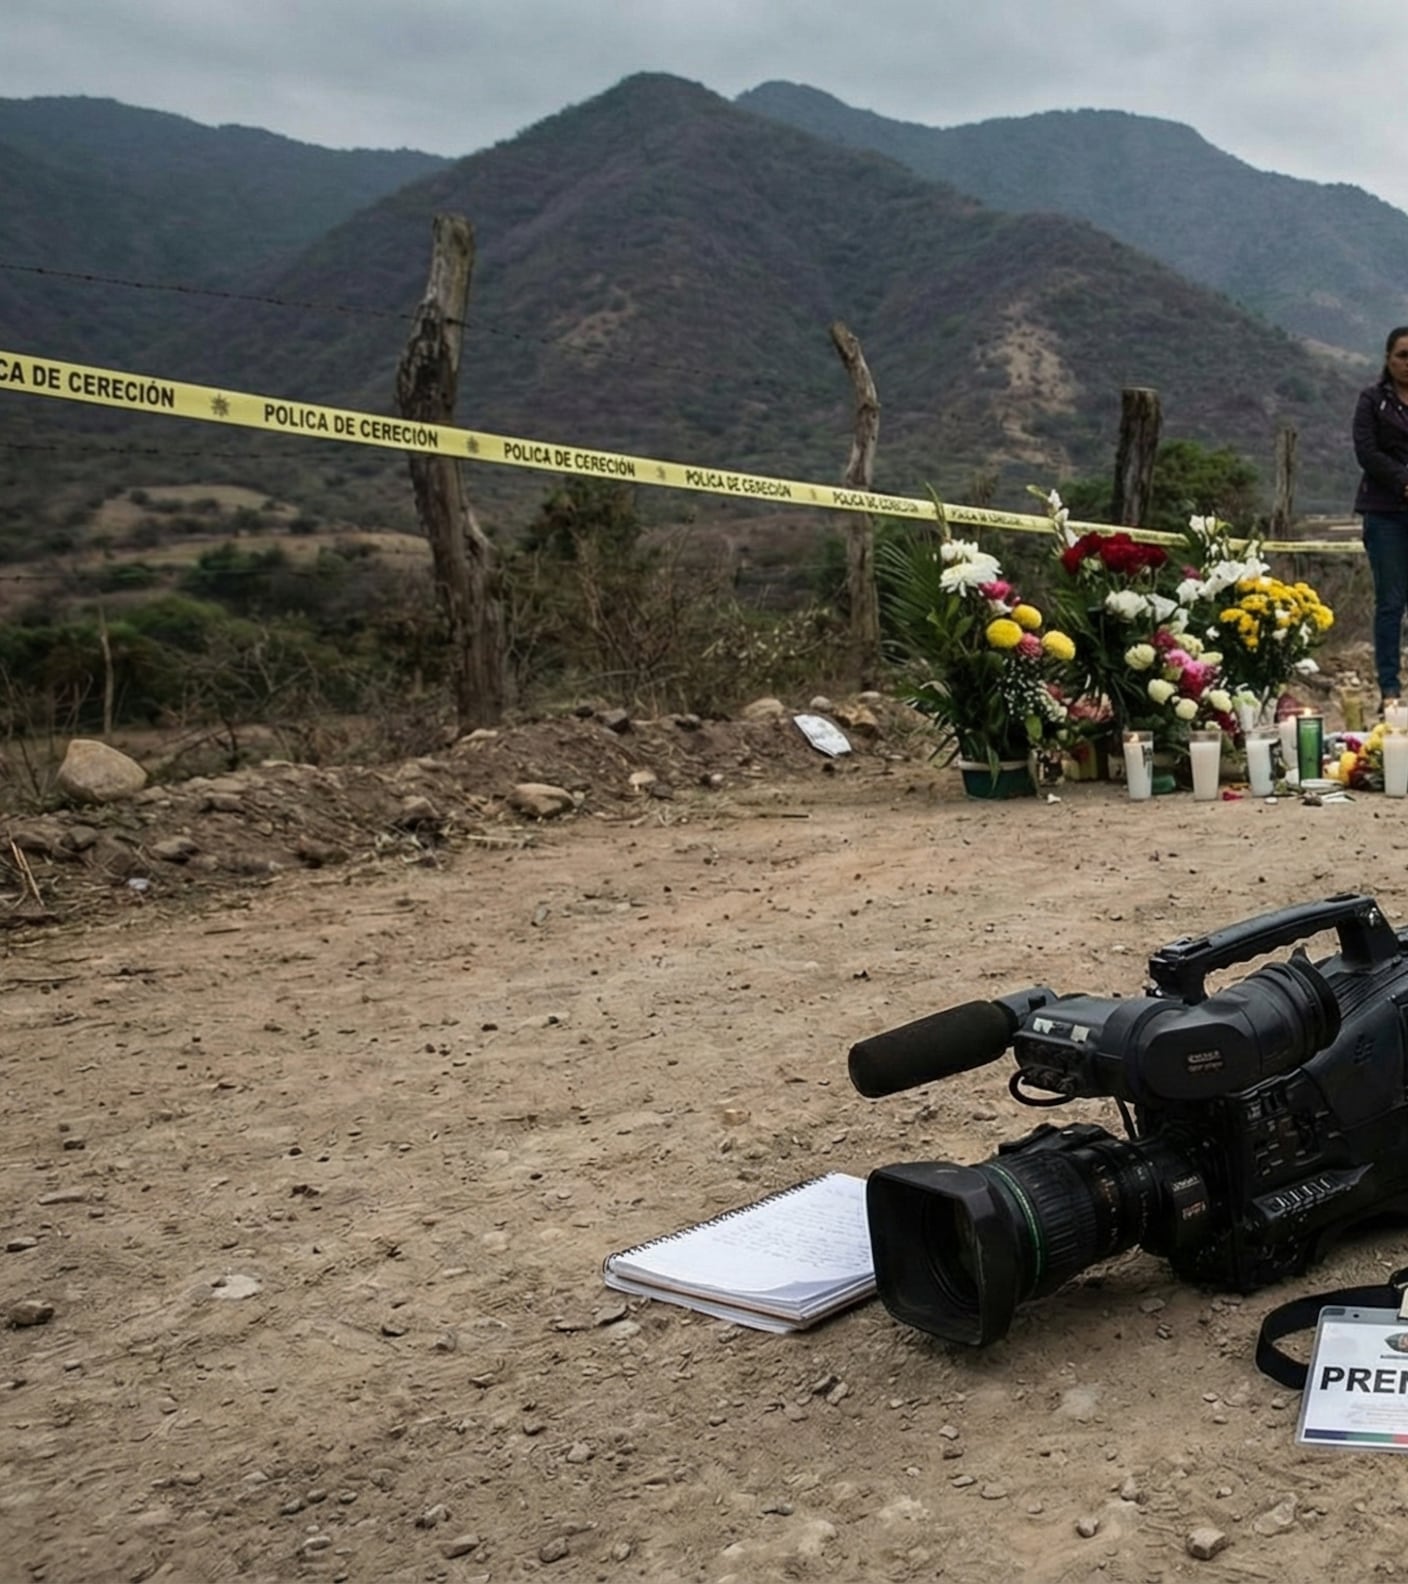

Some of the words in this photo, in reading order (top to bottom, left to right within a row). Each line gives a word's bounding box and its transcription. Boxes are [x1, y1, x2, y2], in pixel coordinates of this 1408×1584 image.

[32, 364, 61, 390] DE
[68, 371, 175, 408] CERECIÓN
[264, 403, 329, 432] POLICA
[334, 415, 356, 436] DE
[360, 419, 438, 448] CERECIÓN
[504, 442, 552, 465] POLICA
[555, 449, 572, 468] DE
